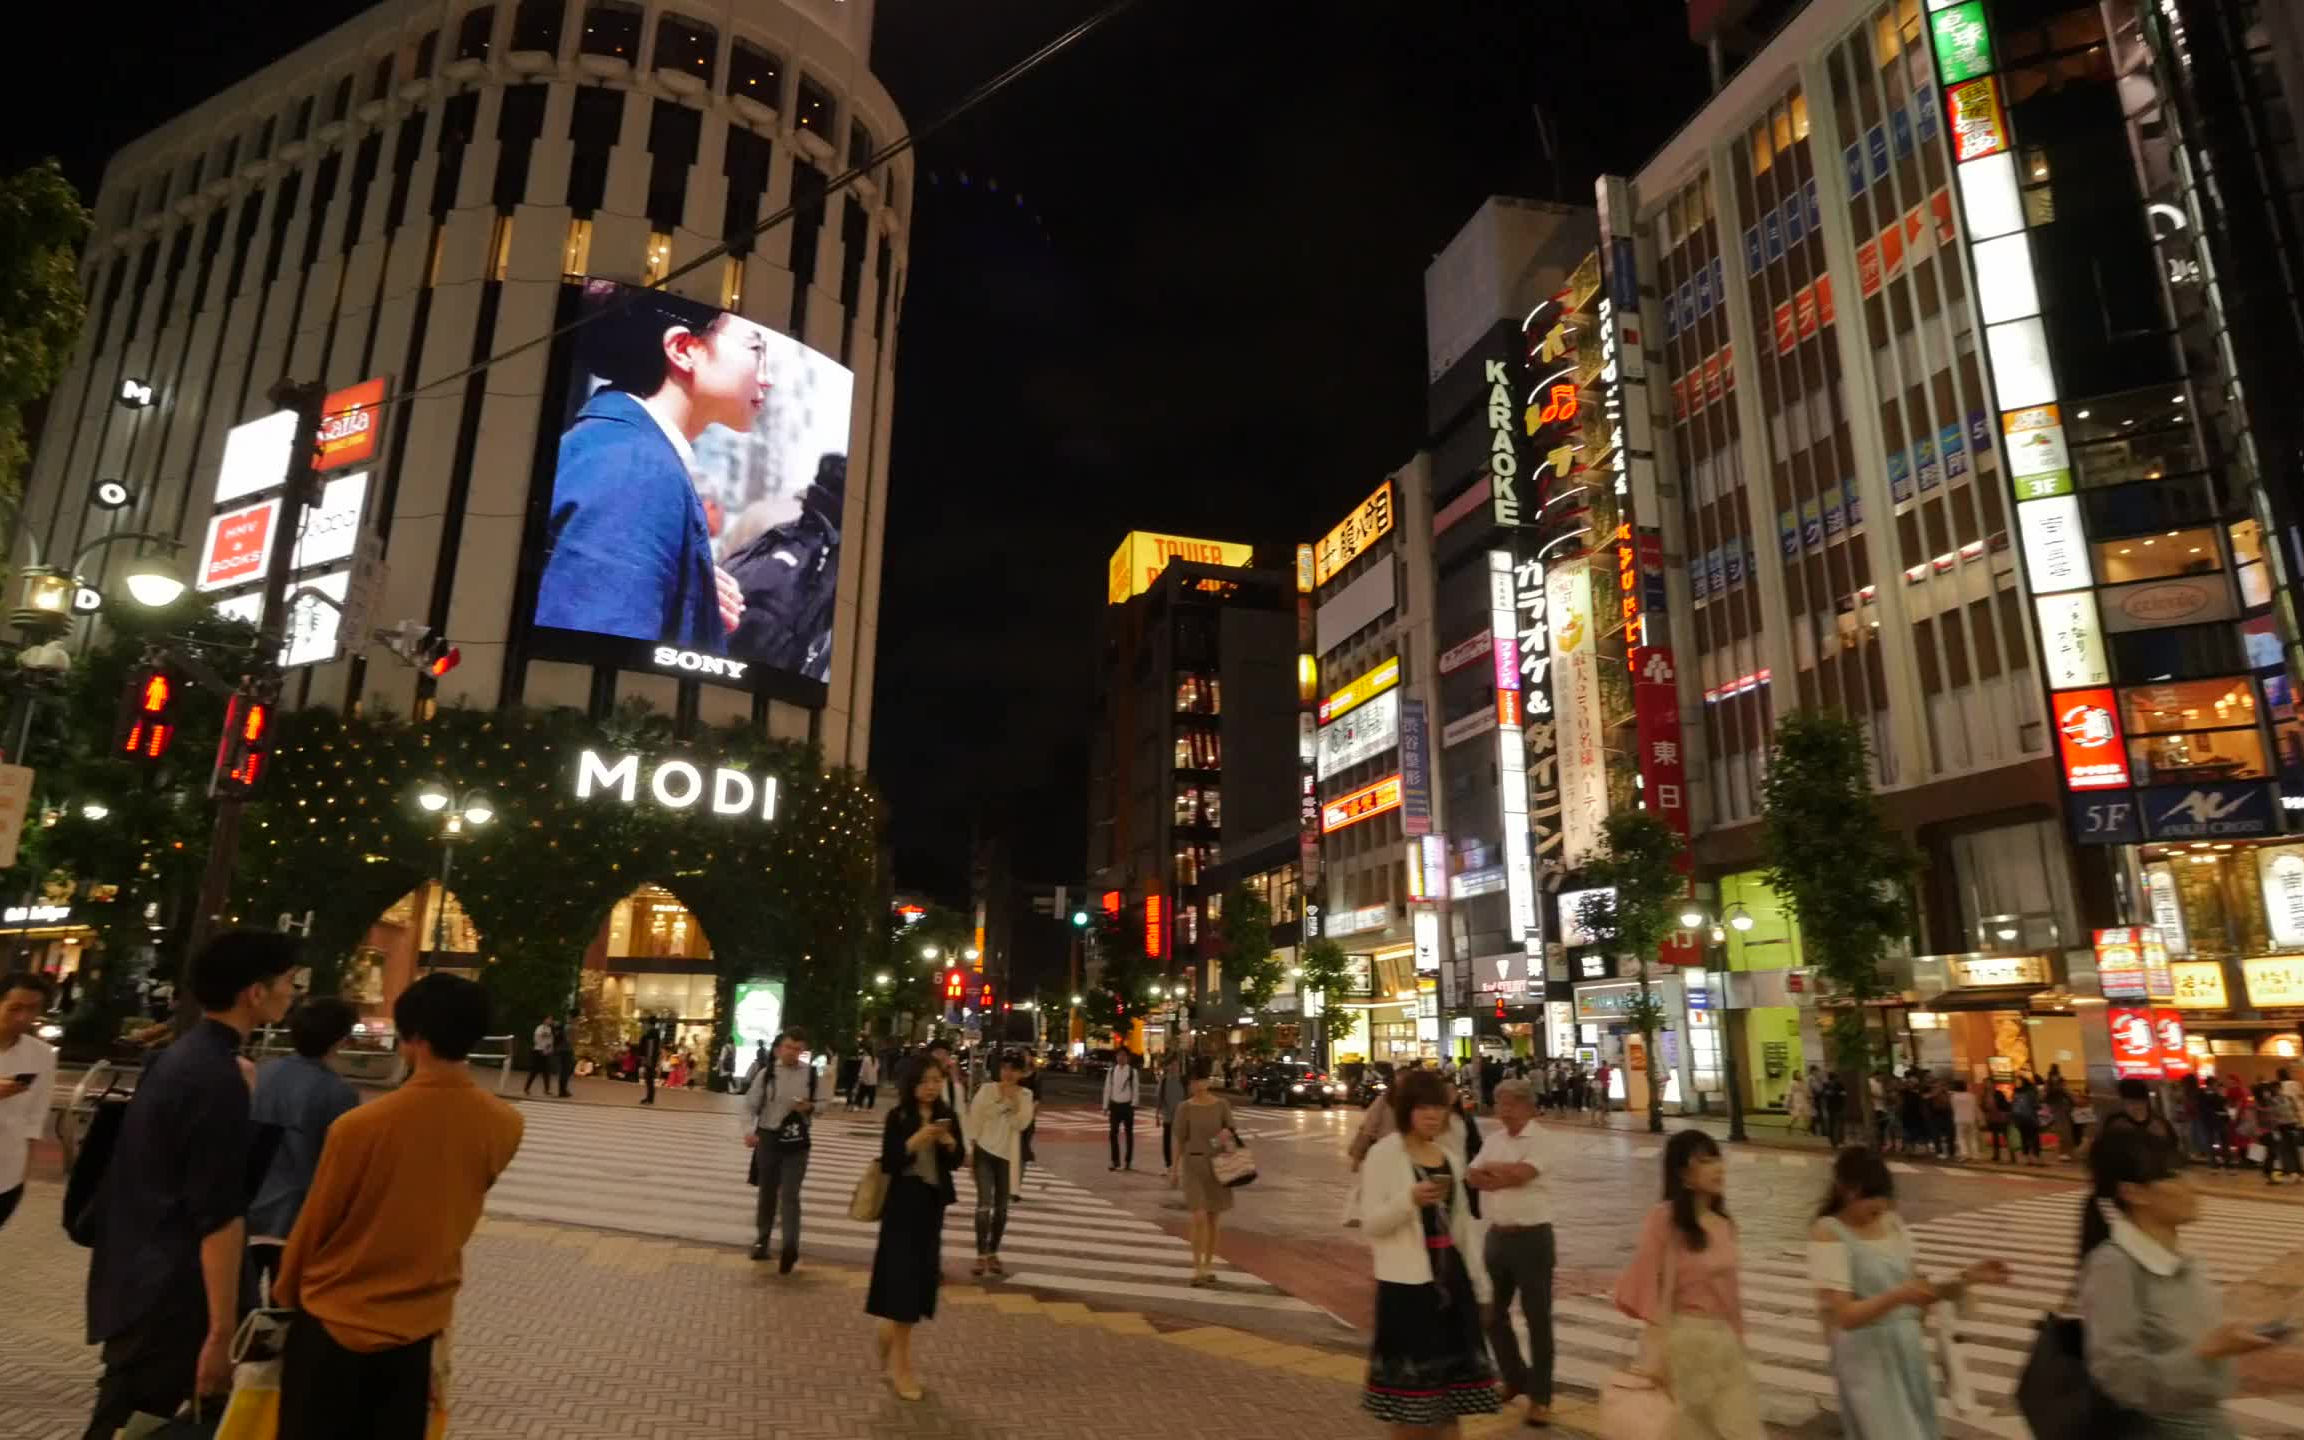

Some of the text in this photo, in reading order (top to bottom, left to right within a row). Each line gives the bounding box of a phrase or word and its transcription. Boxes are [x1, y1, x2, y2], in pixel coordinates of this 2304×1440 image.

[1485, 359, 1519, 526] KARAOKE
[655, 647, 748, 677] SONY
[576, 751, 777, 820] MODI
[2086, 803, 2130, 832] 5F
